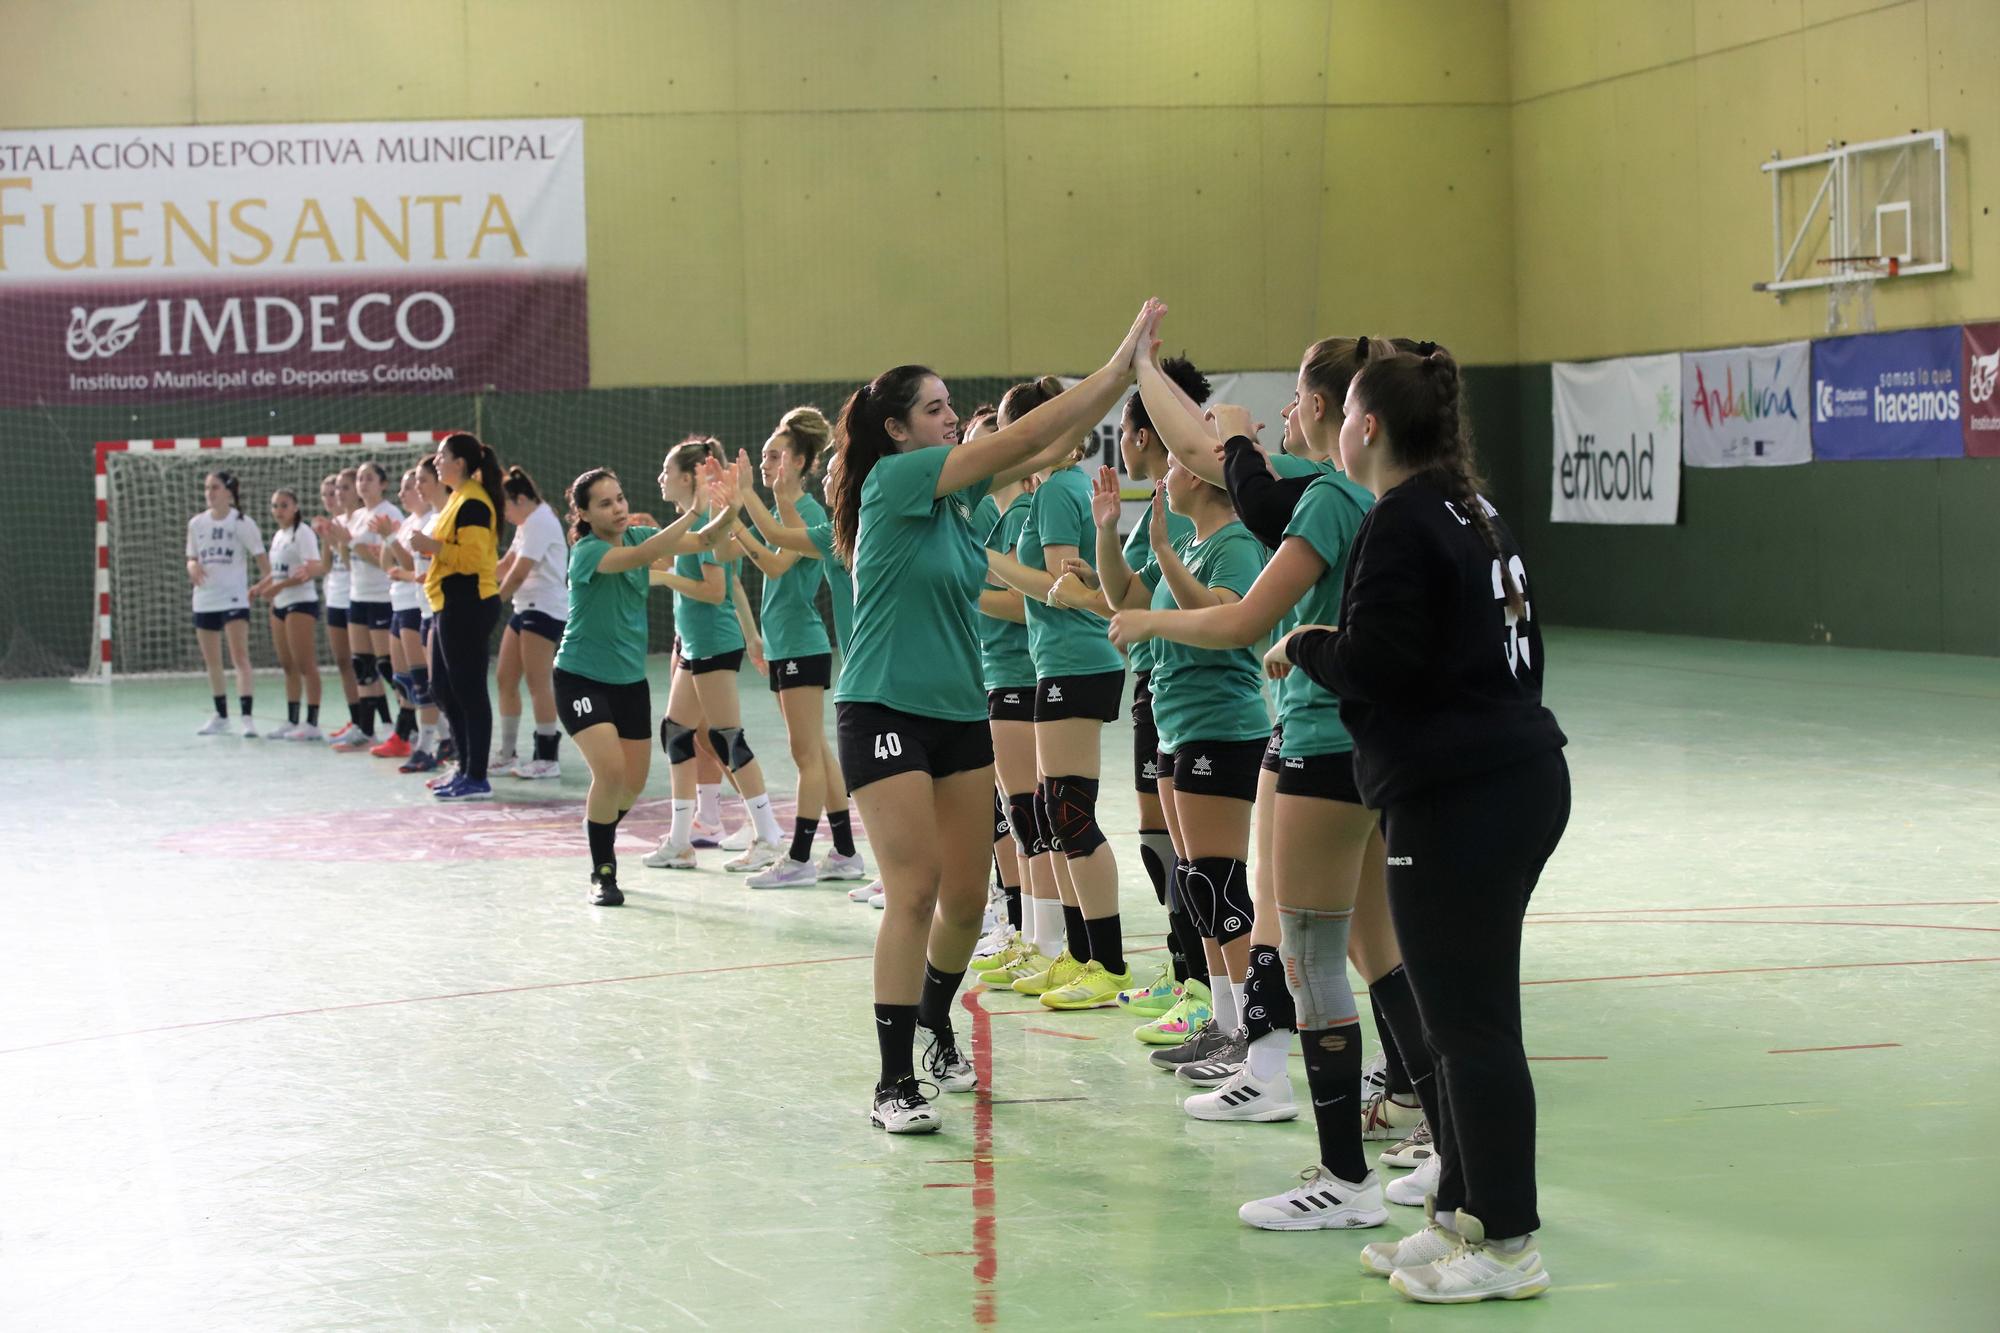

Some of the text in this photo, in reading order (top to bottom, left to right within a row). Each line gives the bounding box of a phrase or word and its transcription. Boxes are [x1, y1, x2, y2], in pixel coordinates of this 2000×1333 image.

[187, 138, 364, 168] DEPORTIVA
[376, 134, 556, 163] MUNICIPAL
[0, 177, 529, 272] FUENSANTA
[157, 291, 456, 357] IMDECO
[70, 363, 454, 391] Instituto Municipal de Deportes Córdoba
[1880, 372, 1915, 388] somos
[1874, 386, 1961, 424] hacemos
[1561, 432, 1654, 501] efficold
[572, 696, 593, 718] 90
[874, 732, 902, 760] 40
[1191, 768, 1213, 777] luanvi
